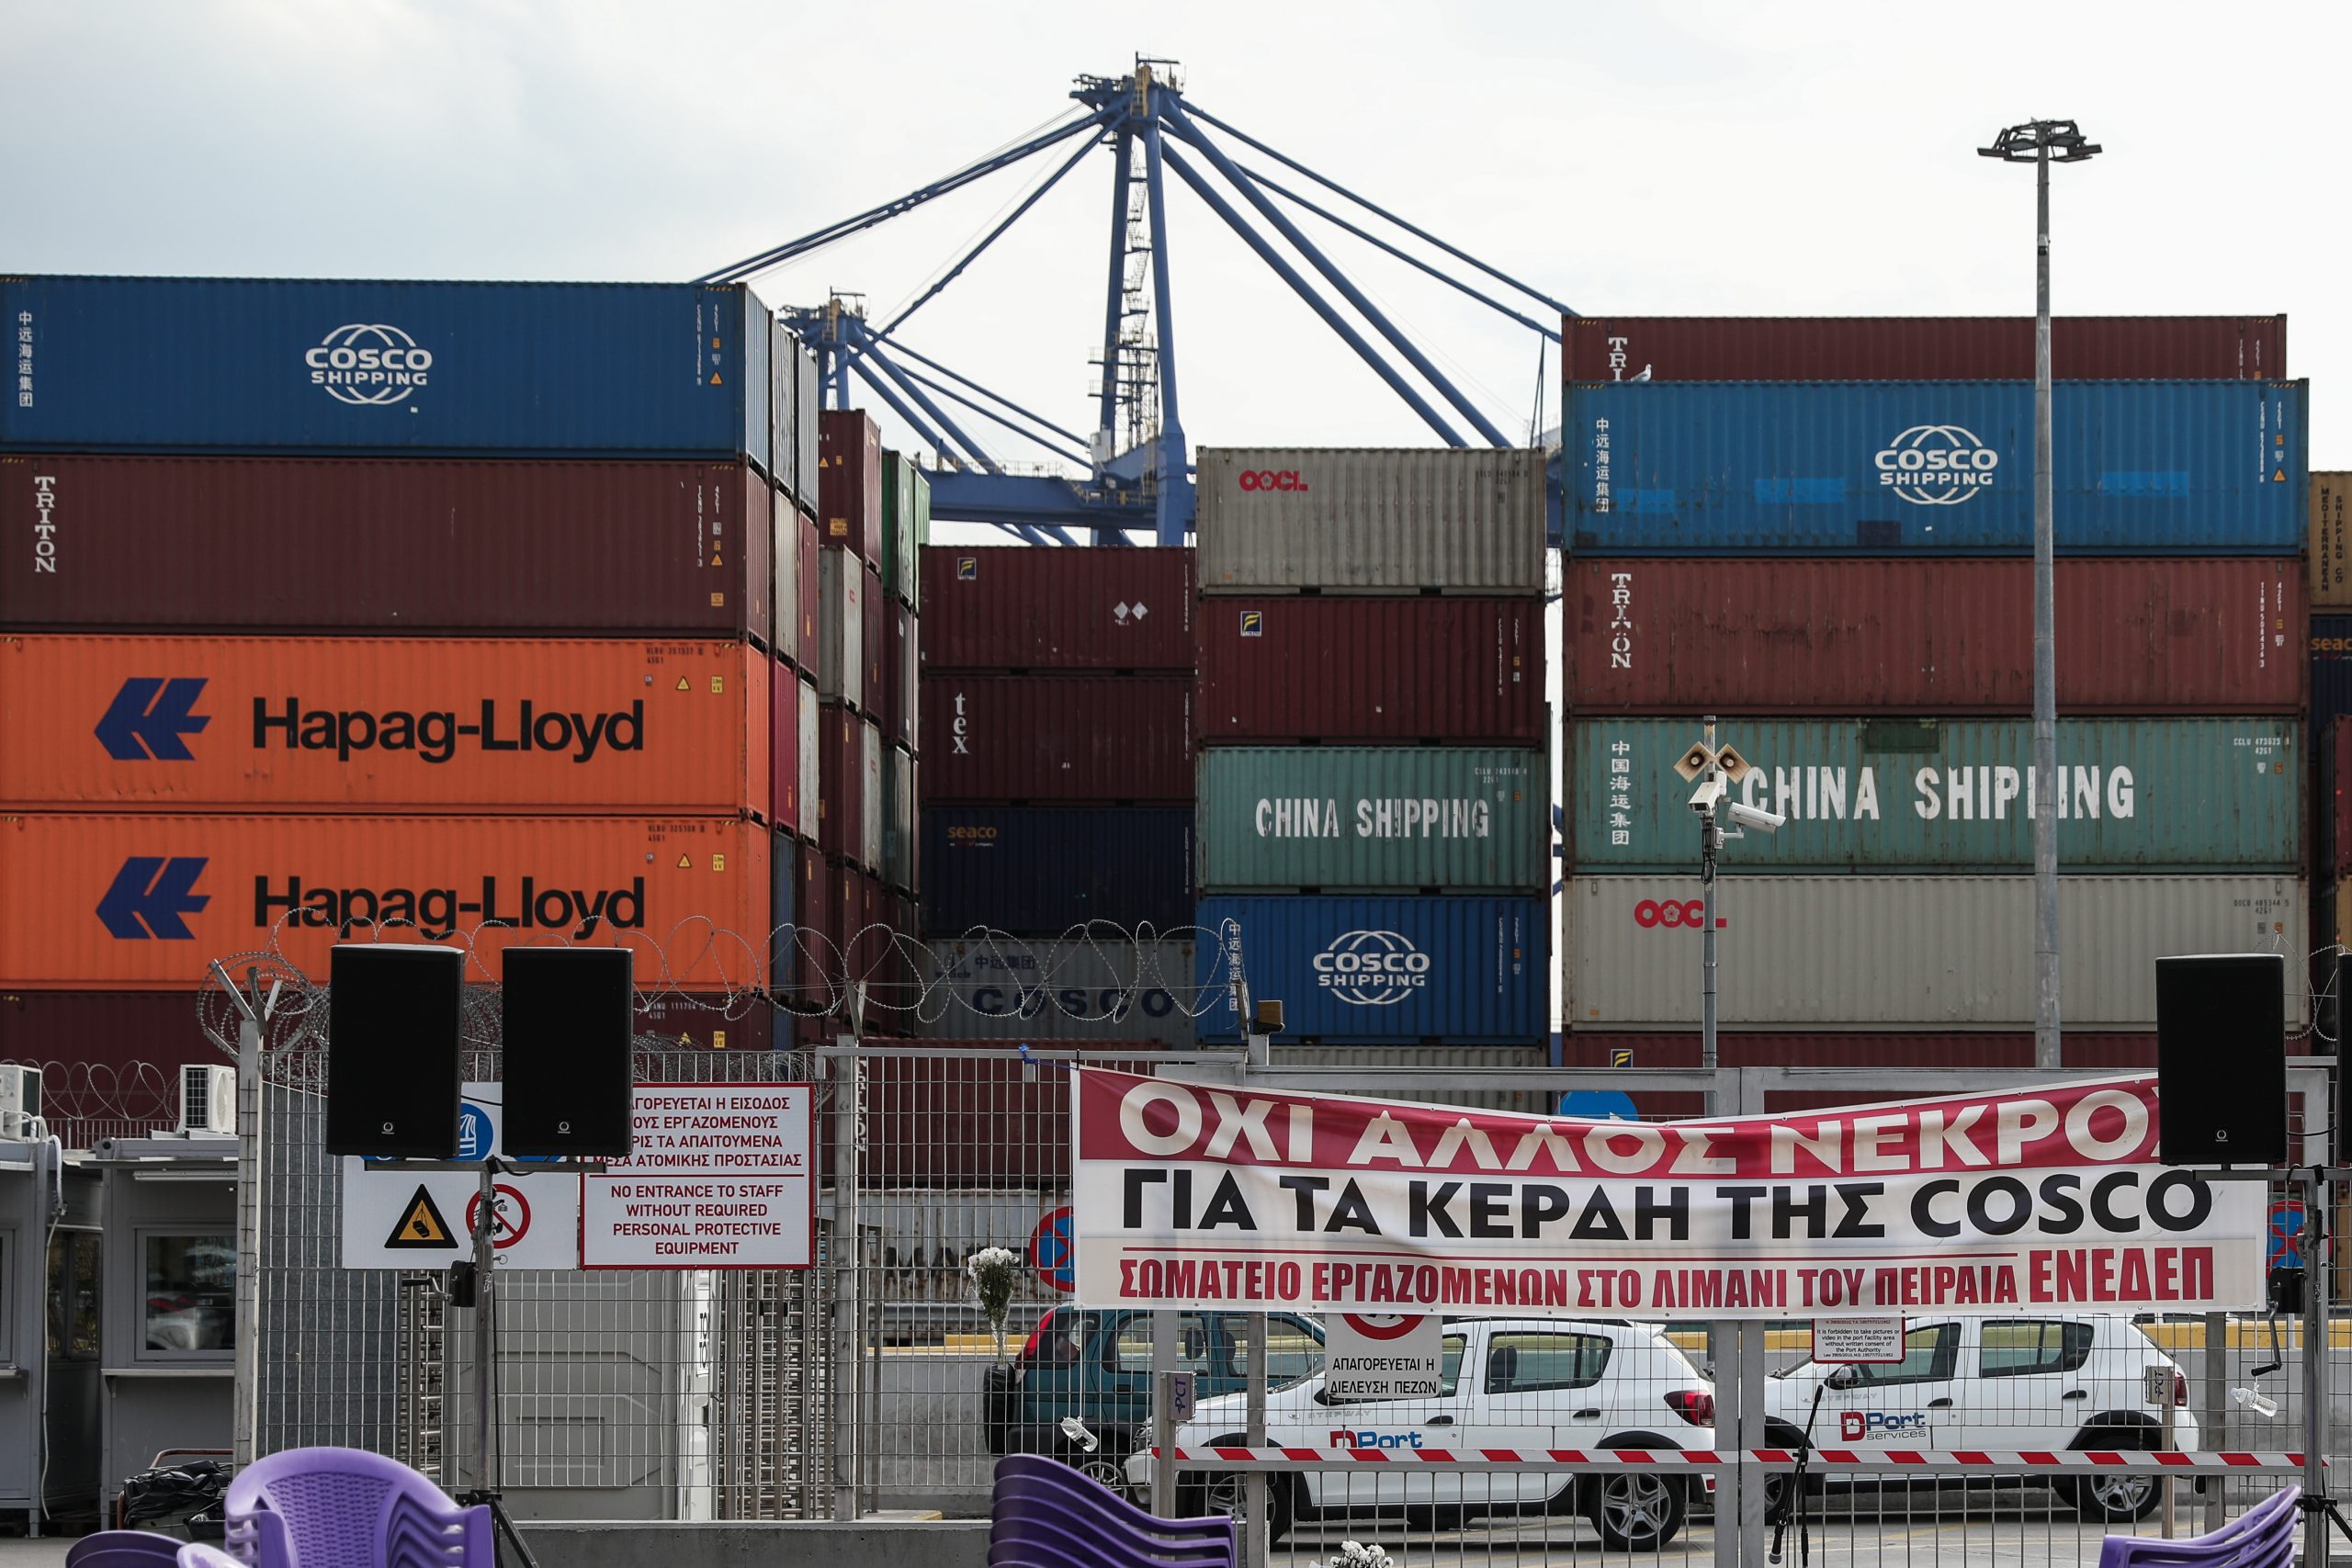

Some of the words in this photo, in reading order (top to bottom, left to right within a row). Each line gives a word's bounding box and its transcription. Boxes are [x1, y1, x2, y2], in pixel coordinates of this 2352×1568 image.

[17, 310, 33, 409] 中远海运集团
[305, 346, 433, 370] COSCO
[1608, 336, 1628, 381] TRI
[311, 370, 428, 386] SHIPPING
[1595, 417, 1610, 513] 中远海运集团
[1875, 448, 1998, 471] COSCO
[1238, 469, 1308, 492] OOCL
[1880, 472, 1994, 486] SHIPPING
[34, 475, 56, 574] TRITON
[2321, 488, 2329, 592] MEDITERRANEAN
[1611, 573, 1632, 669] TRITON
[2311, 637, 2352, 650] seac
[253, 696, 643, 763] Hapag-Lloyd
[952, 692, 970, 755] tex
[1610, 739, 1632, 845] 中国海运集团
[1742, 766, 1880, 820] CHINA
[1255, 797, 1340, 838] CHINA
[1356, 797, 1489, 838] SHIPPING
[947, 826, 997, 839] seaco
[255, 875, 645, 941] Hapag-Lloyd
[1313, 952, 1430, 973] COSCO
[1317, 974, 1425, 987] SHIPPING
[972, 987, 1174, 1018] COSCO
[716, 1097, 726, 1111] Η
[731, 1097, 790, 1111] ΕΙΣΟΔΟΣ
[633, 1116, 660, 1129] ΟΥΣ
[663, 1116, 778, 1129] ΕΡΓΑΖΟΜΕΝΟΥΣ
[1119, 1081, 1314, 1164] ΟΧΙ
[1347, 1110, 1737, 1175] ΑΛΛΟΣ
[1770, 1086, 2159, 1175] ΝΕΚΡΟ
[632, 1135, 653, 1148] ΡΙΣ
[656, 1135, 675, 1147] ΤΑ
[679, 1135, 783, 1147] ΑΠΑΙΤΟΥΜΕΝΑ
[636, 1154, 710, 1168] ΑΤΟΜΙΚΗΣ
[714, 1154, 802, 1167] ΠΡΟΣΤΑΣΙΑΣ
[610, 1185, 632, 1198] NO
[638, 1185, 713, 1198] ENTRANCE
[716, 1185, 735, 1198] TO
[738, 1185, 784, 1198] STAFF
[626, 1203, 690, 1217] WITHOUT
[694, 1203, 768, 1217] REQUIRED
[1124, 1168, 1258, 1231] ΓΙΑ
[1279, 1174, 1383, 1235] ΤΑ
[1409, 1180, 1689, 1241] ΚΕΡΔΗ
[1716, 1181, 1885, 1240] ΤΗΣ
[1910, 1168, 2212, 1238] COSCO
[613, 1223, 690, 1235] PERSONAL
[695, 1223, 781, 1235] PROTECTIVE
[654, 1242, 739, 1255] EQUIPMENT
[1119, 1259, 1301, 1301] ΣΩΜΑΤΕΙΟ
[1312, 1263, 1566, 1307] ΕΡΓΑΖΟΜΕΝΩΝ
[1577, 1269, 1642, 1309] ΣΤΟ
[1653, 1269, 1787, 1308] ΛΙΜΑΝΙ
[1798, 1269, 1862, 1307] ΤΟΥ
[1875, 1265, 2018, 1306] ΠΕΙΡΑΙΑ
[2029, 1247, 2215, 1303] ΕΝΕΔΕΠ
[1332, 1358, 1420, 1371] ΑΠΑΓΟΡΕΥΕΤΑΙ
[1426, 1359, 1434, 1371] Η
[1175, 1378, 1186, 1409] PCT
[1330, 1381, 1388, 1393] ΔΙΕΛΕΥΣΗ
[1395, 1381, 1437, 1393] ΠΕΖΩΝ
[1866, 1429, 1927, 1441] services
